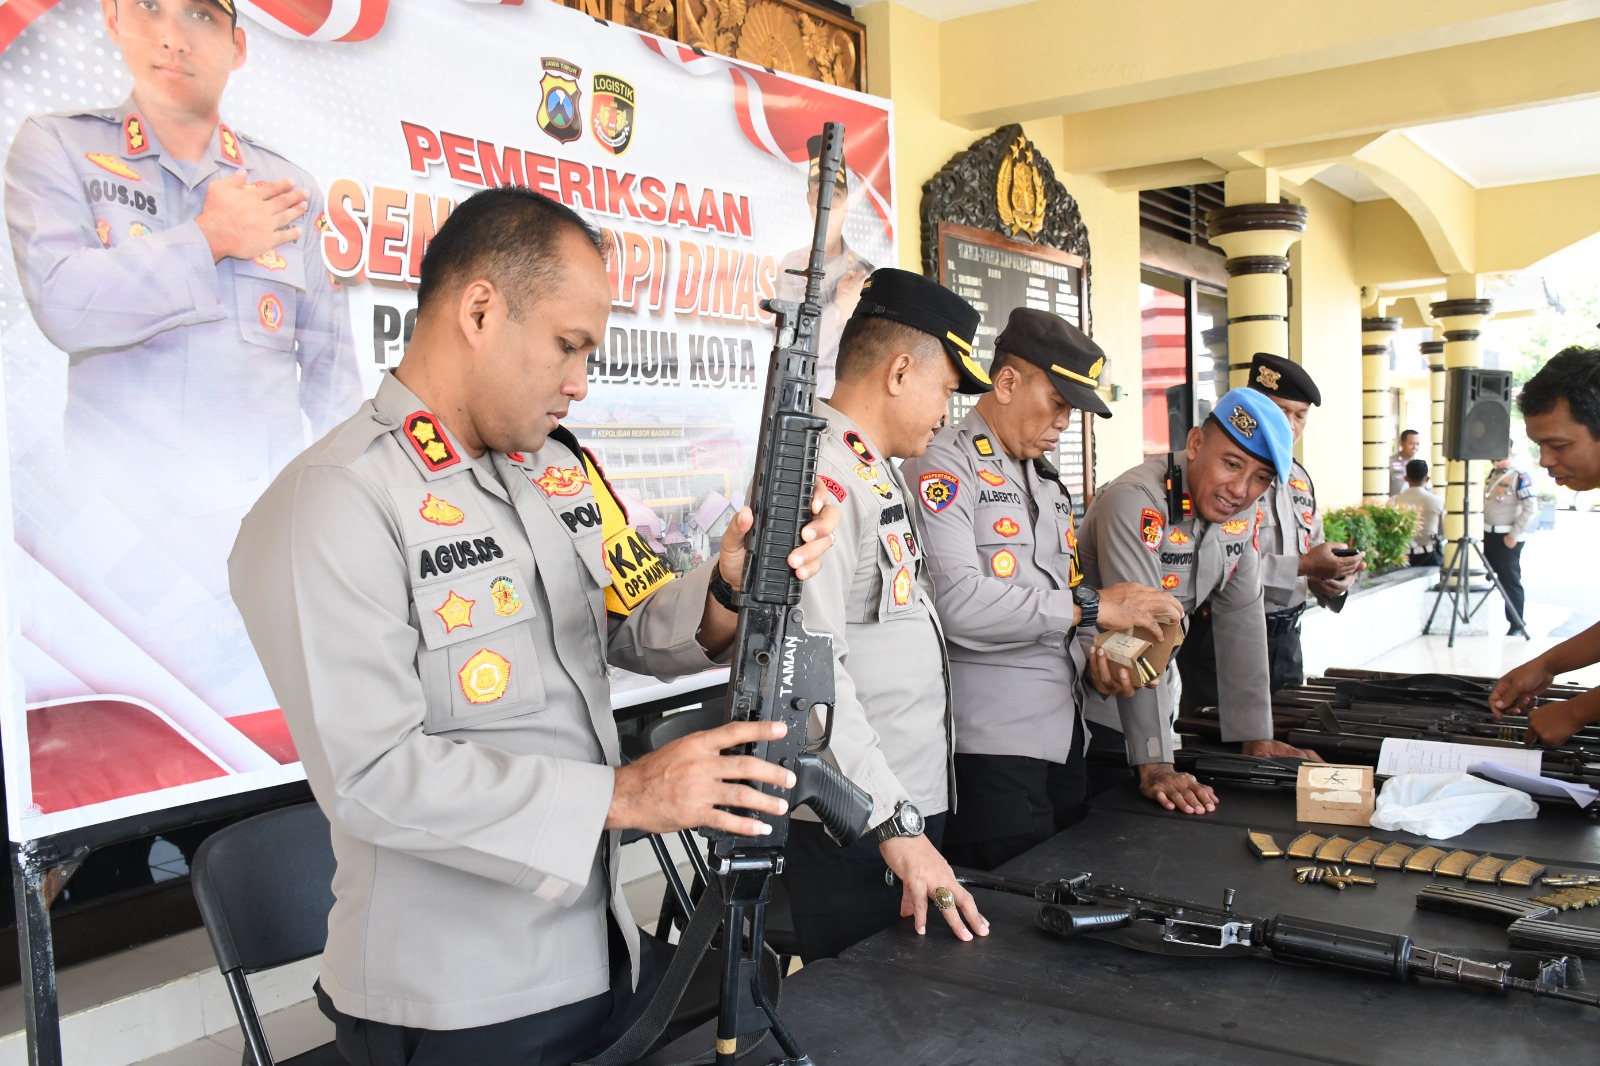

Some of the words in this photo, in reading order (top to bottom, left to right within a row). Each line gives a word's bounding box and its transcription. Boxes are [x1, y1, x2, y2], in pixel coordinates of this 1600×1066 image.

[545, 60, 559, 68] JAWA
[560, 63, 577, 75] TIMUR
[595, 78, 634, 100] LOGISTIK
[401, 120, 753, 238] PEMERIKSAAN
[674, 239, 778, 323] DINAS
[586, 326, 679, 381] ADIUN
[688, 333, 757, 385] KOTA
[631, 429, 650, 438] RESOR
[978, 489, 1020, 505] ALBERTO
[420, 536, 504, 580] AGUS.DS
[624, 574, 647, 598] OPS
[780, 635, 804, 698] TAMAN
